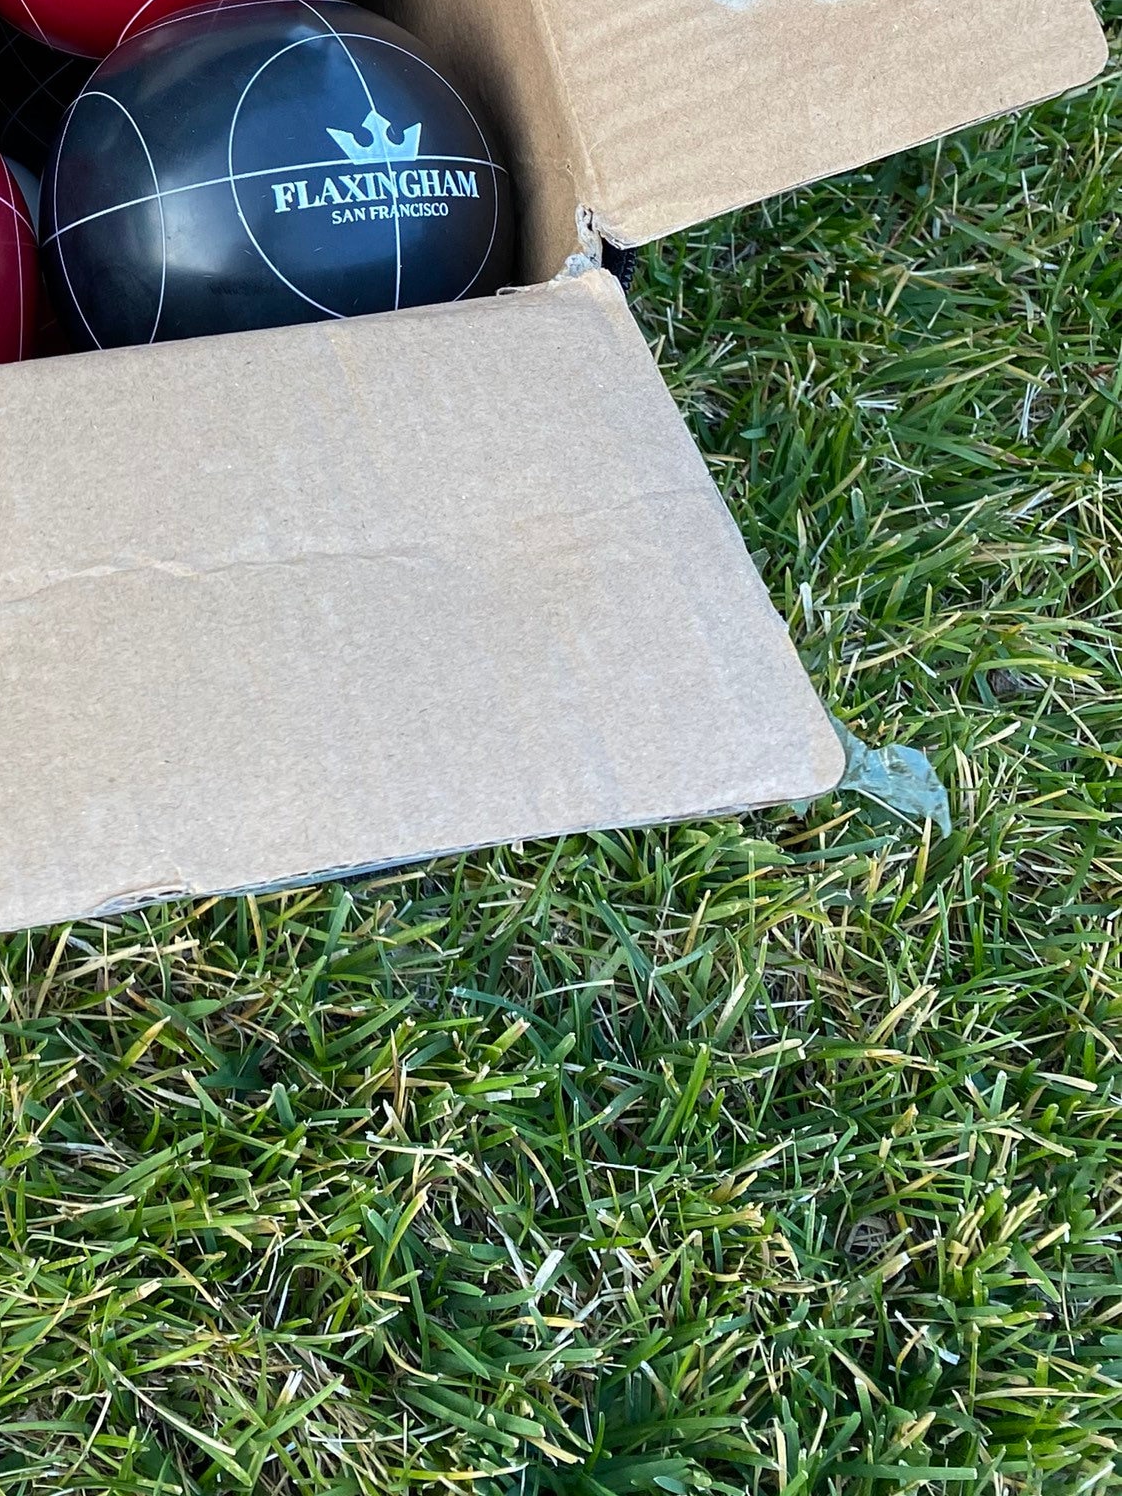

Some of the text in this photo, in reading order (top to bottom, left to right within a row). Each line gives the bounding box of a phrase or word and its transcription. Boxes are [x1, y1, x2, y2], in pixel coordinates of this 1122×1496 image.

[271, 169, 480, 214] FLAXINGHAM
[331, 202, 449, 225] SAN FRANCISCO
